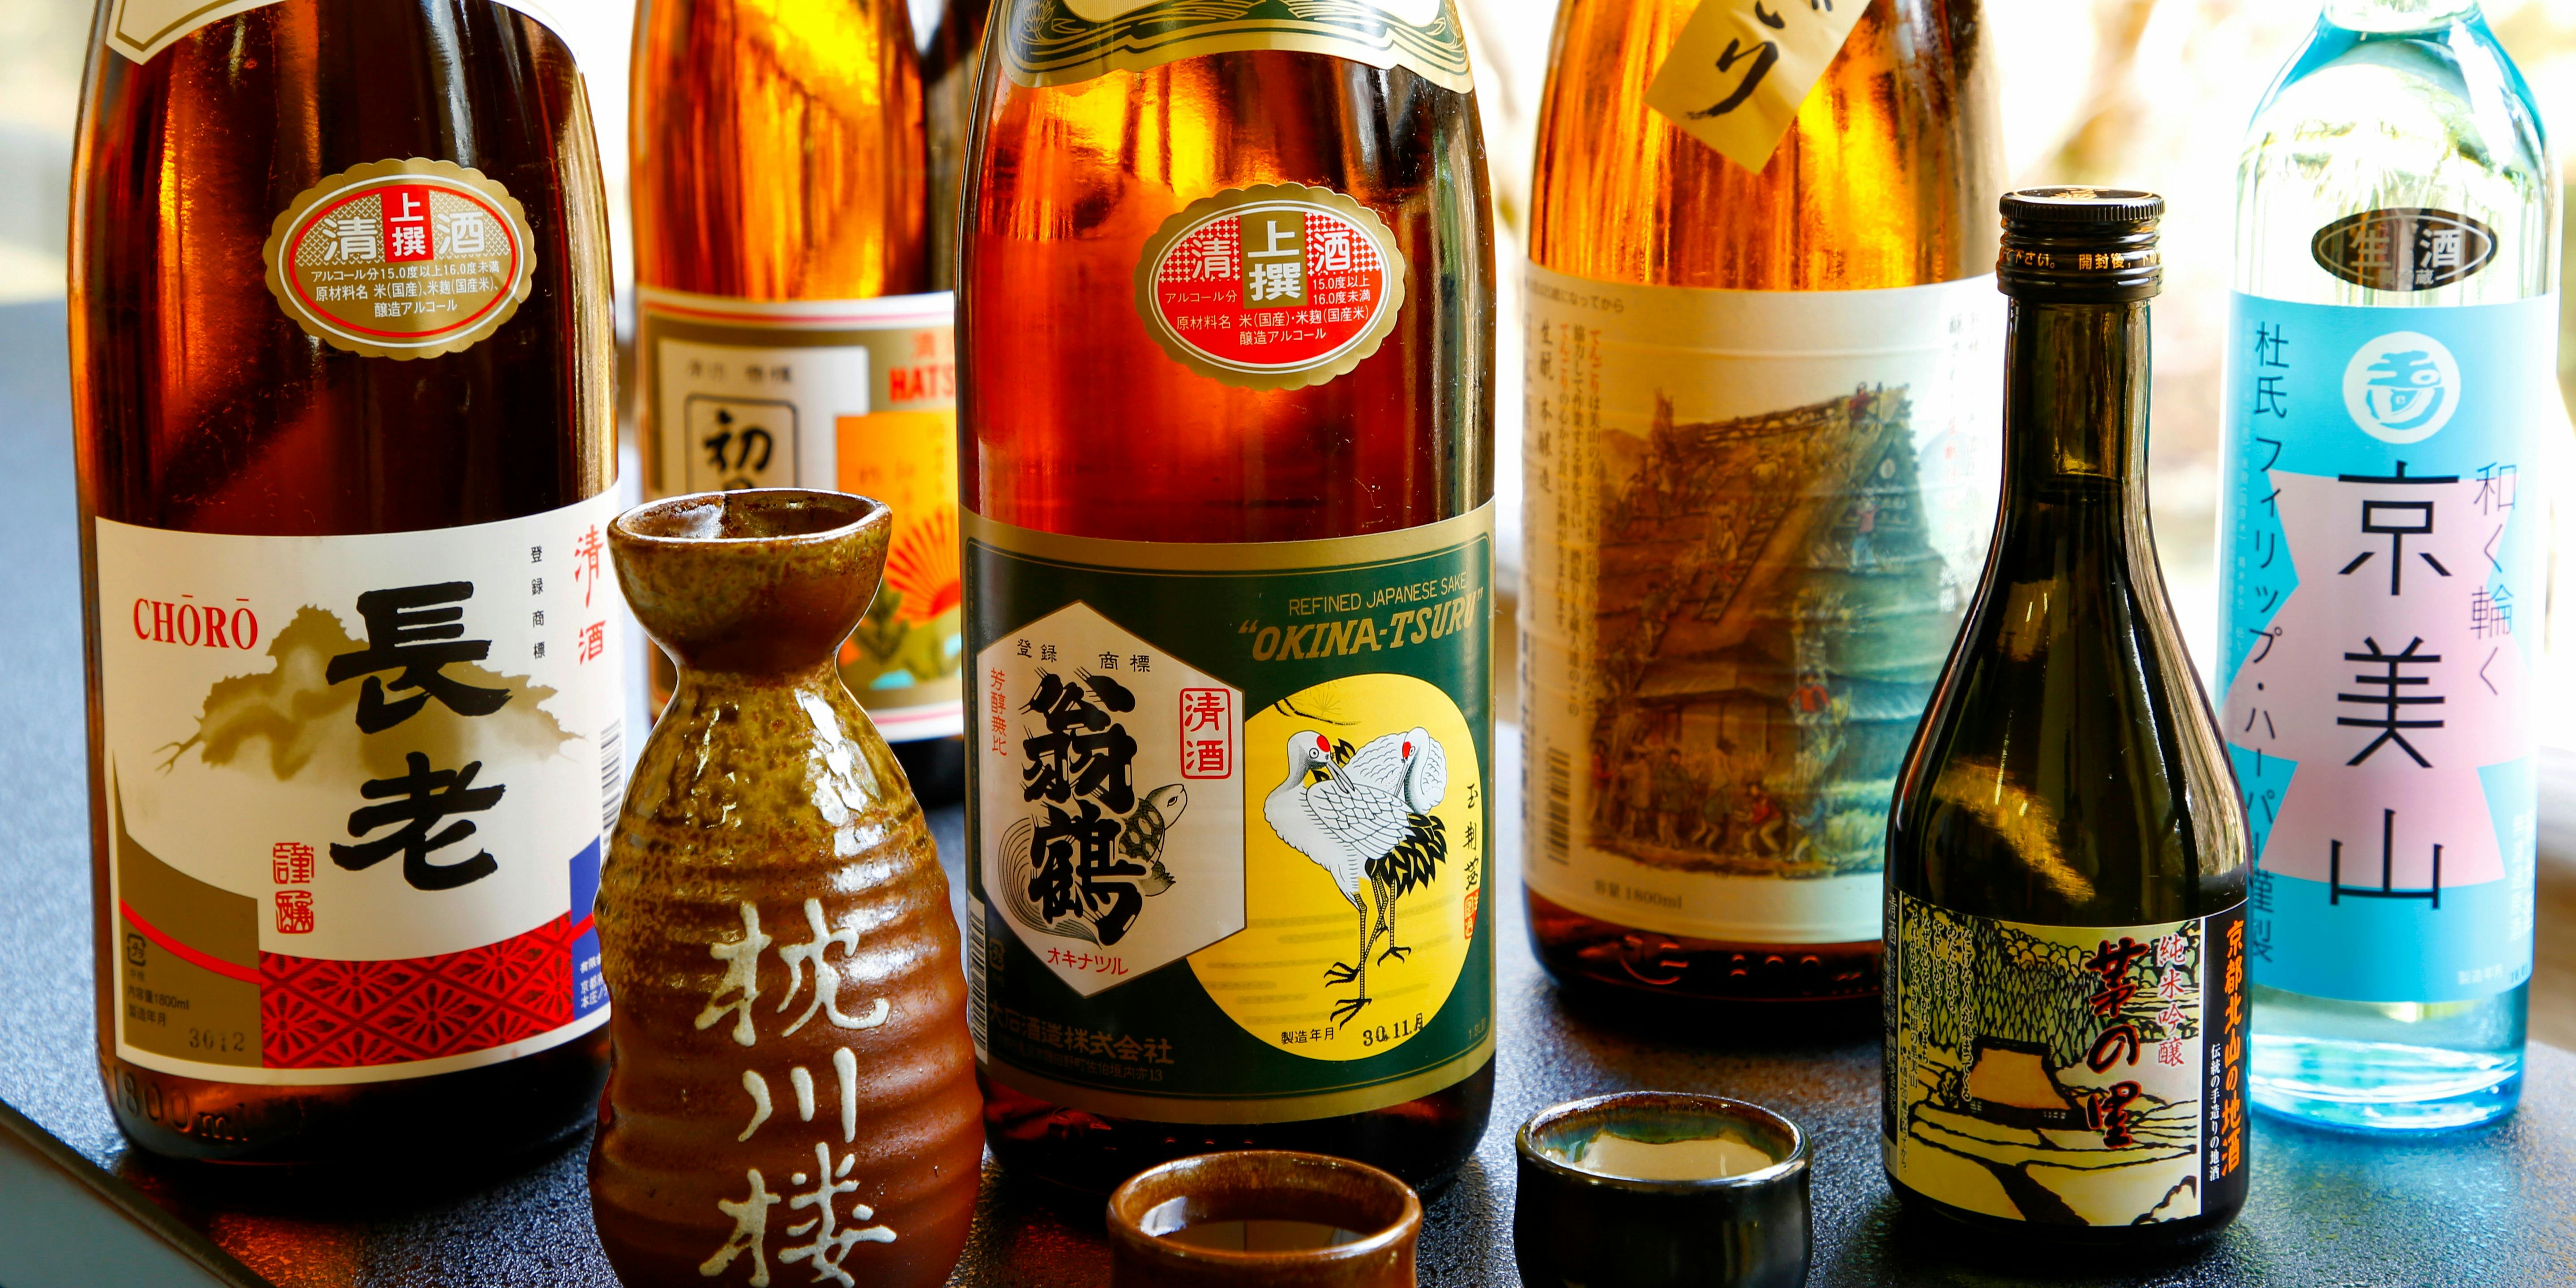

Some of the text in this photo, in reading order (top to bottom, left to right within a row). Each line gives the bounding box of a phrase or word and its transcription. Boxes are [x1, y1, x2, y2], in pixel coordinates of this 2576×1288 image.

[390, 193, 426, 257] 上撰
[1247, 220, 1301, 301] 上撰
[316, 285, 368, 302] 原材料名
[1165, 291, 1238, 304] アルコール分
[1313, 278, 1370, 291] 15.0度以上
[1313, 290, 1371, 305] 16.0度未満
[1176, 314, 1231, 330] 原材料名
[530, 545, 547, 660] 登録商標
[574, 524, 606, 665] 清酒
[1289, 572, 1467, 616] REFINED JAPANESE SAKE
[2469, 462, 2516, 696] 和く輪く
[133, 594, 258, 650] CHŌRŌ
[2330, 460, 2461, 910] 京美山
[325, 581, 513, 891] 長老
[1184, 692, 1226, 773] 清酒
[1047, 947, 1128, 976] オキナツル
[1281, 1027, 1335, 1045] 製造年月
[2156, 933, 2187, 1068] 純米吟醸
[2221, 920, 2244, 1177] 京都北山の地酒
[2209, 1043, 2221, 1182] 伝統の手造りの地酒
